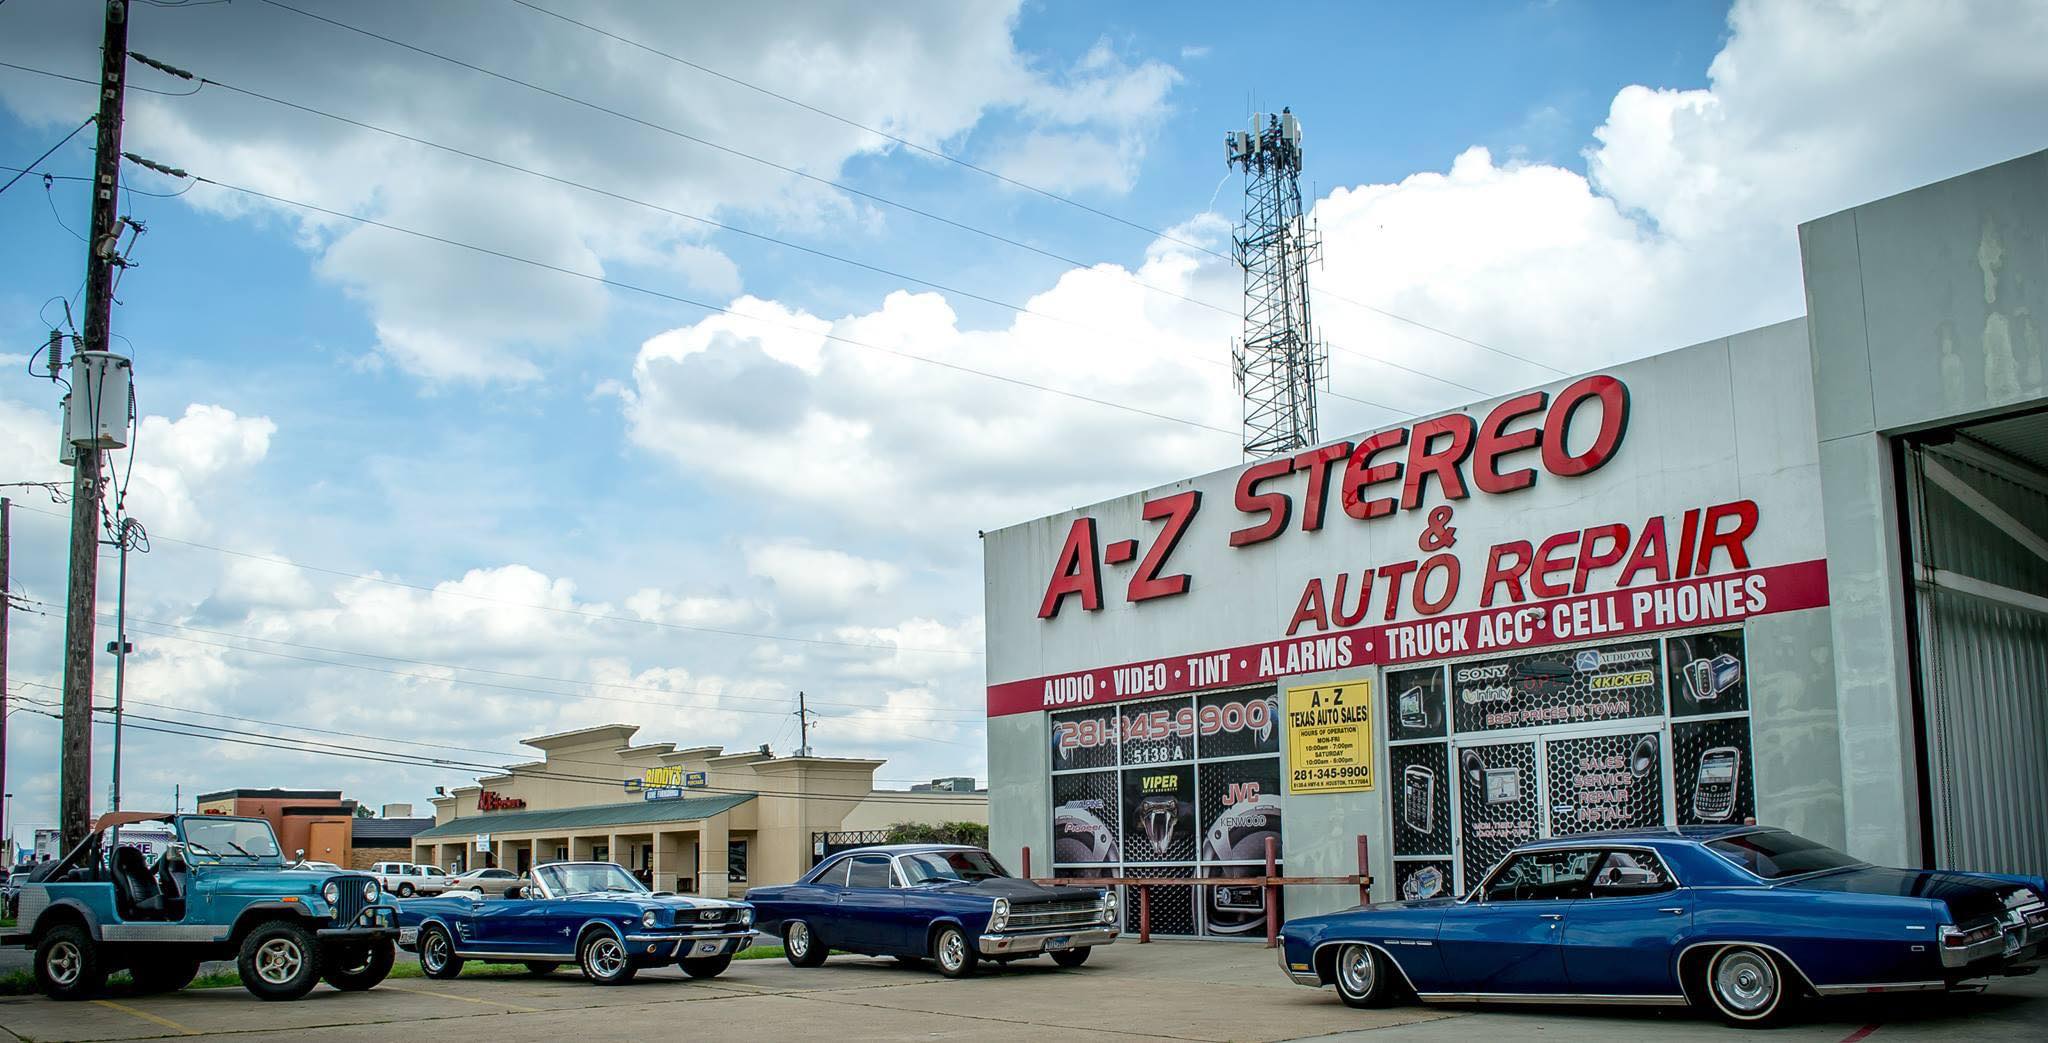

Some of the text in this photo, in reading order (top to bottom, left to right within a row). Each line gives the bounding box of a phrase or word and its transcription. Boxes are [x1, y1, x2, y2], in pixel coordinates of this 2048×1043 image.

[1229, 374, 1630, 547] STEREO
[1418, 505, 1457, 552] &
[1038, 490, 1203, 618] A-Z
[1285, 499, 1759, 635] AUTO REPAIR
[1043, 573, 1768, 706] AUDIO VIDEO TINT ALARMS TRUCK ACC CELL PHONES
[1600, 649, 1652, 664] AUDIOVOX
[1458, 665, 1507, 682] SONY
[1602, 672, 1651, 688] KICKER
[1312, 690, 1321, 708] A
[1333, 688, 1343, 706] Z
[1290, 705, 1368, 728] TEXAS AUTO SALES
[1486, 701, 1630, 726] BEST PRICES IN TOWN
[1059, 699, 1270, 749] 281-345-9900
[1301, 726, 1357, 737] HOURS OF OPERATION
[1317, 736, 1341, 744] MON-FRI
[1133, 744, 1185, 765] 5138 A
[1315, 750, 1344, 758] SATURDAY
[1579, 755, 1624, 771] SALES
[1294, 766, 1368, 781] 281-345-9900
[1573, 772, 1632, 788] SERVICE
[1142, 775, 1178, 789] VIPER
[1222, 782, 1261, 806] JVC
[1578, 789, 1629, 804] REPAIR
[1077, 799, 1104, 809] ALPINE
[1219, 814, 1267, 828] KENWOOD
[1577, 805, 1632, 822] INSTALL
[1064, 823, 1103, 834] Pioneer
